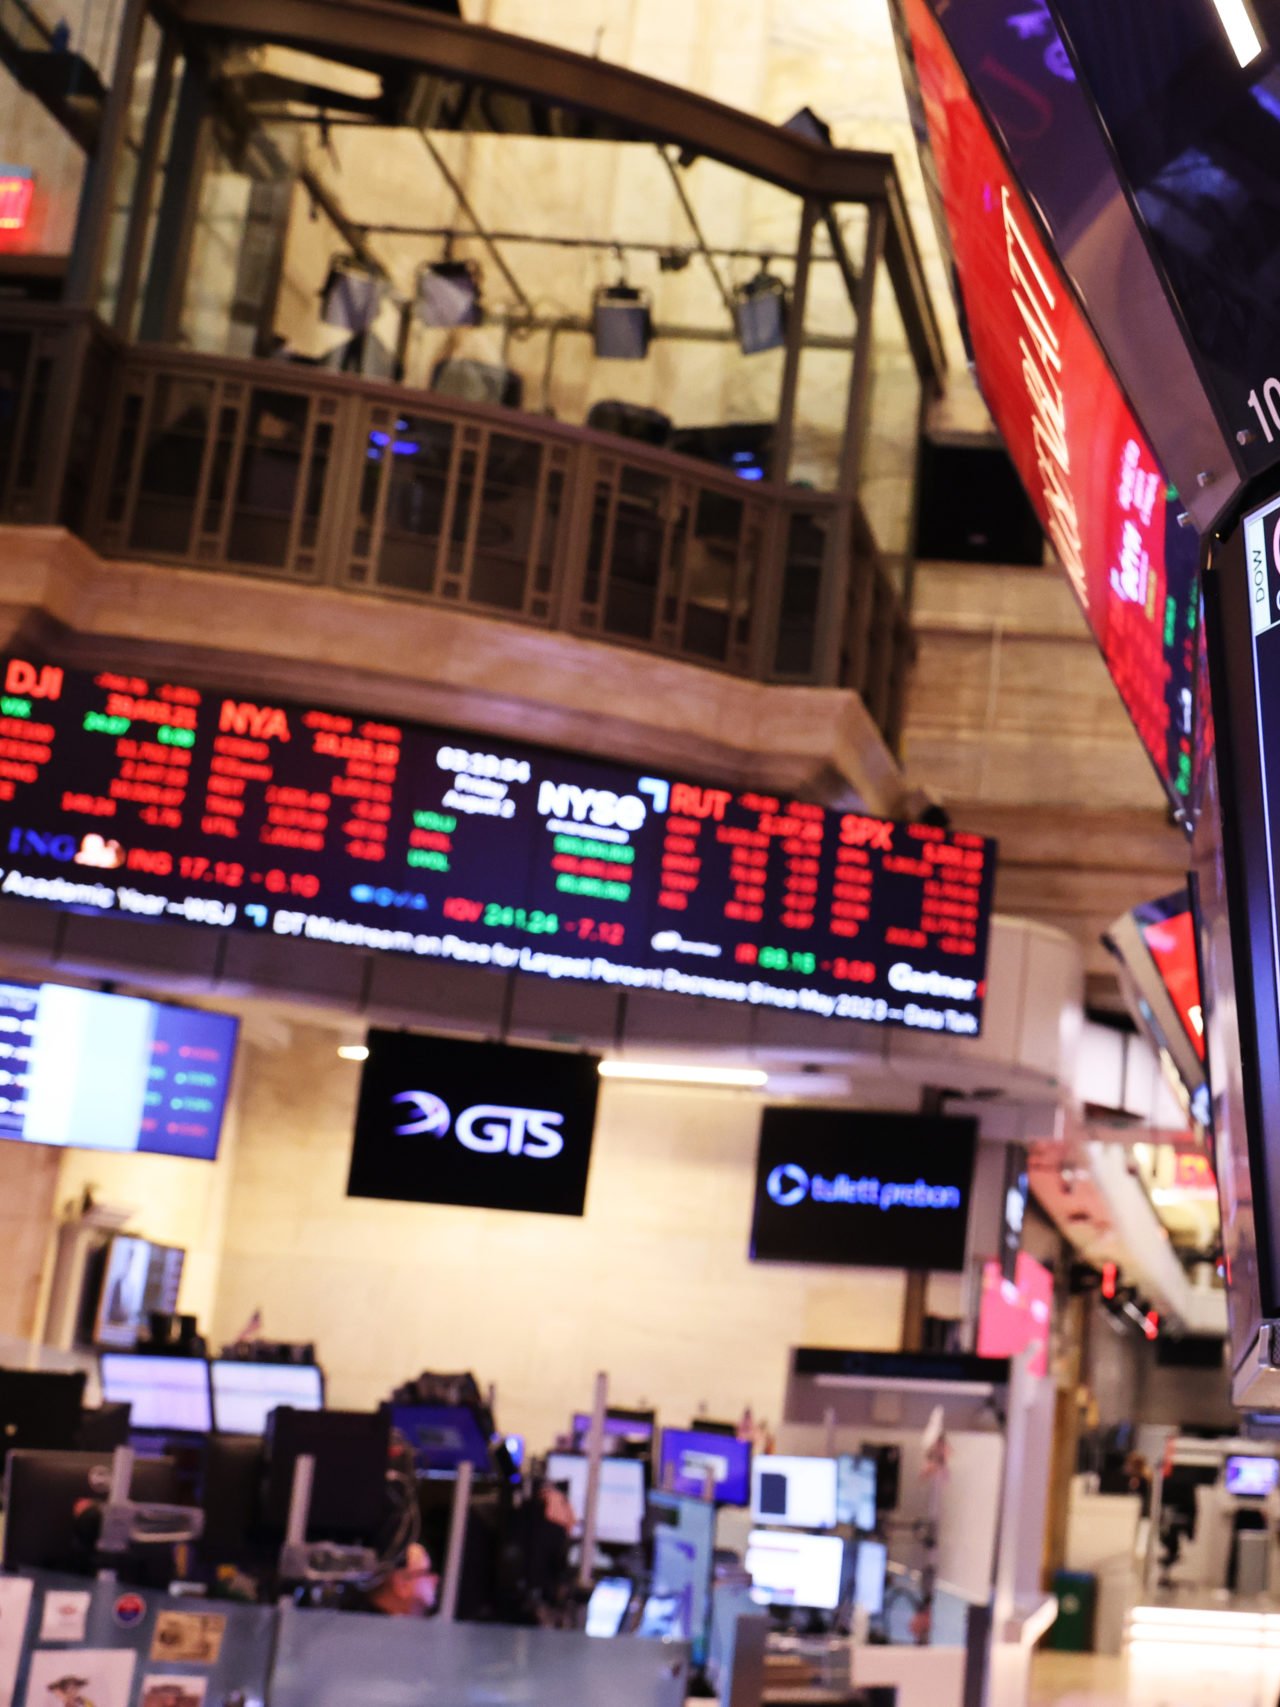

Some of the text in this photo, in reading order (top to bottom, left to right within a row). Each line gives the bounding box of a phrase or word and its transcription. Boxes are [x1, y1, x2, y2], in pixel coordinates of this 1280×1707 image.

[1253, 550, 1265, 603] DOW
[219, 699, 290, 743] NYA
[454, 1104, 564, 1159] GTS
